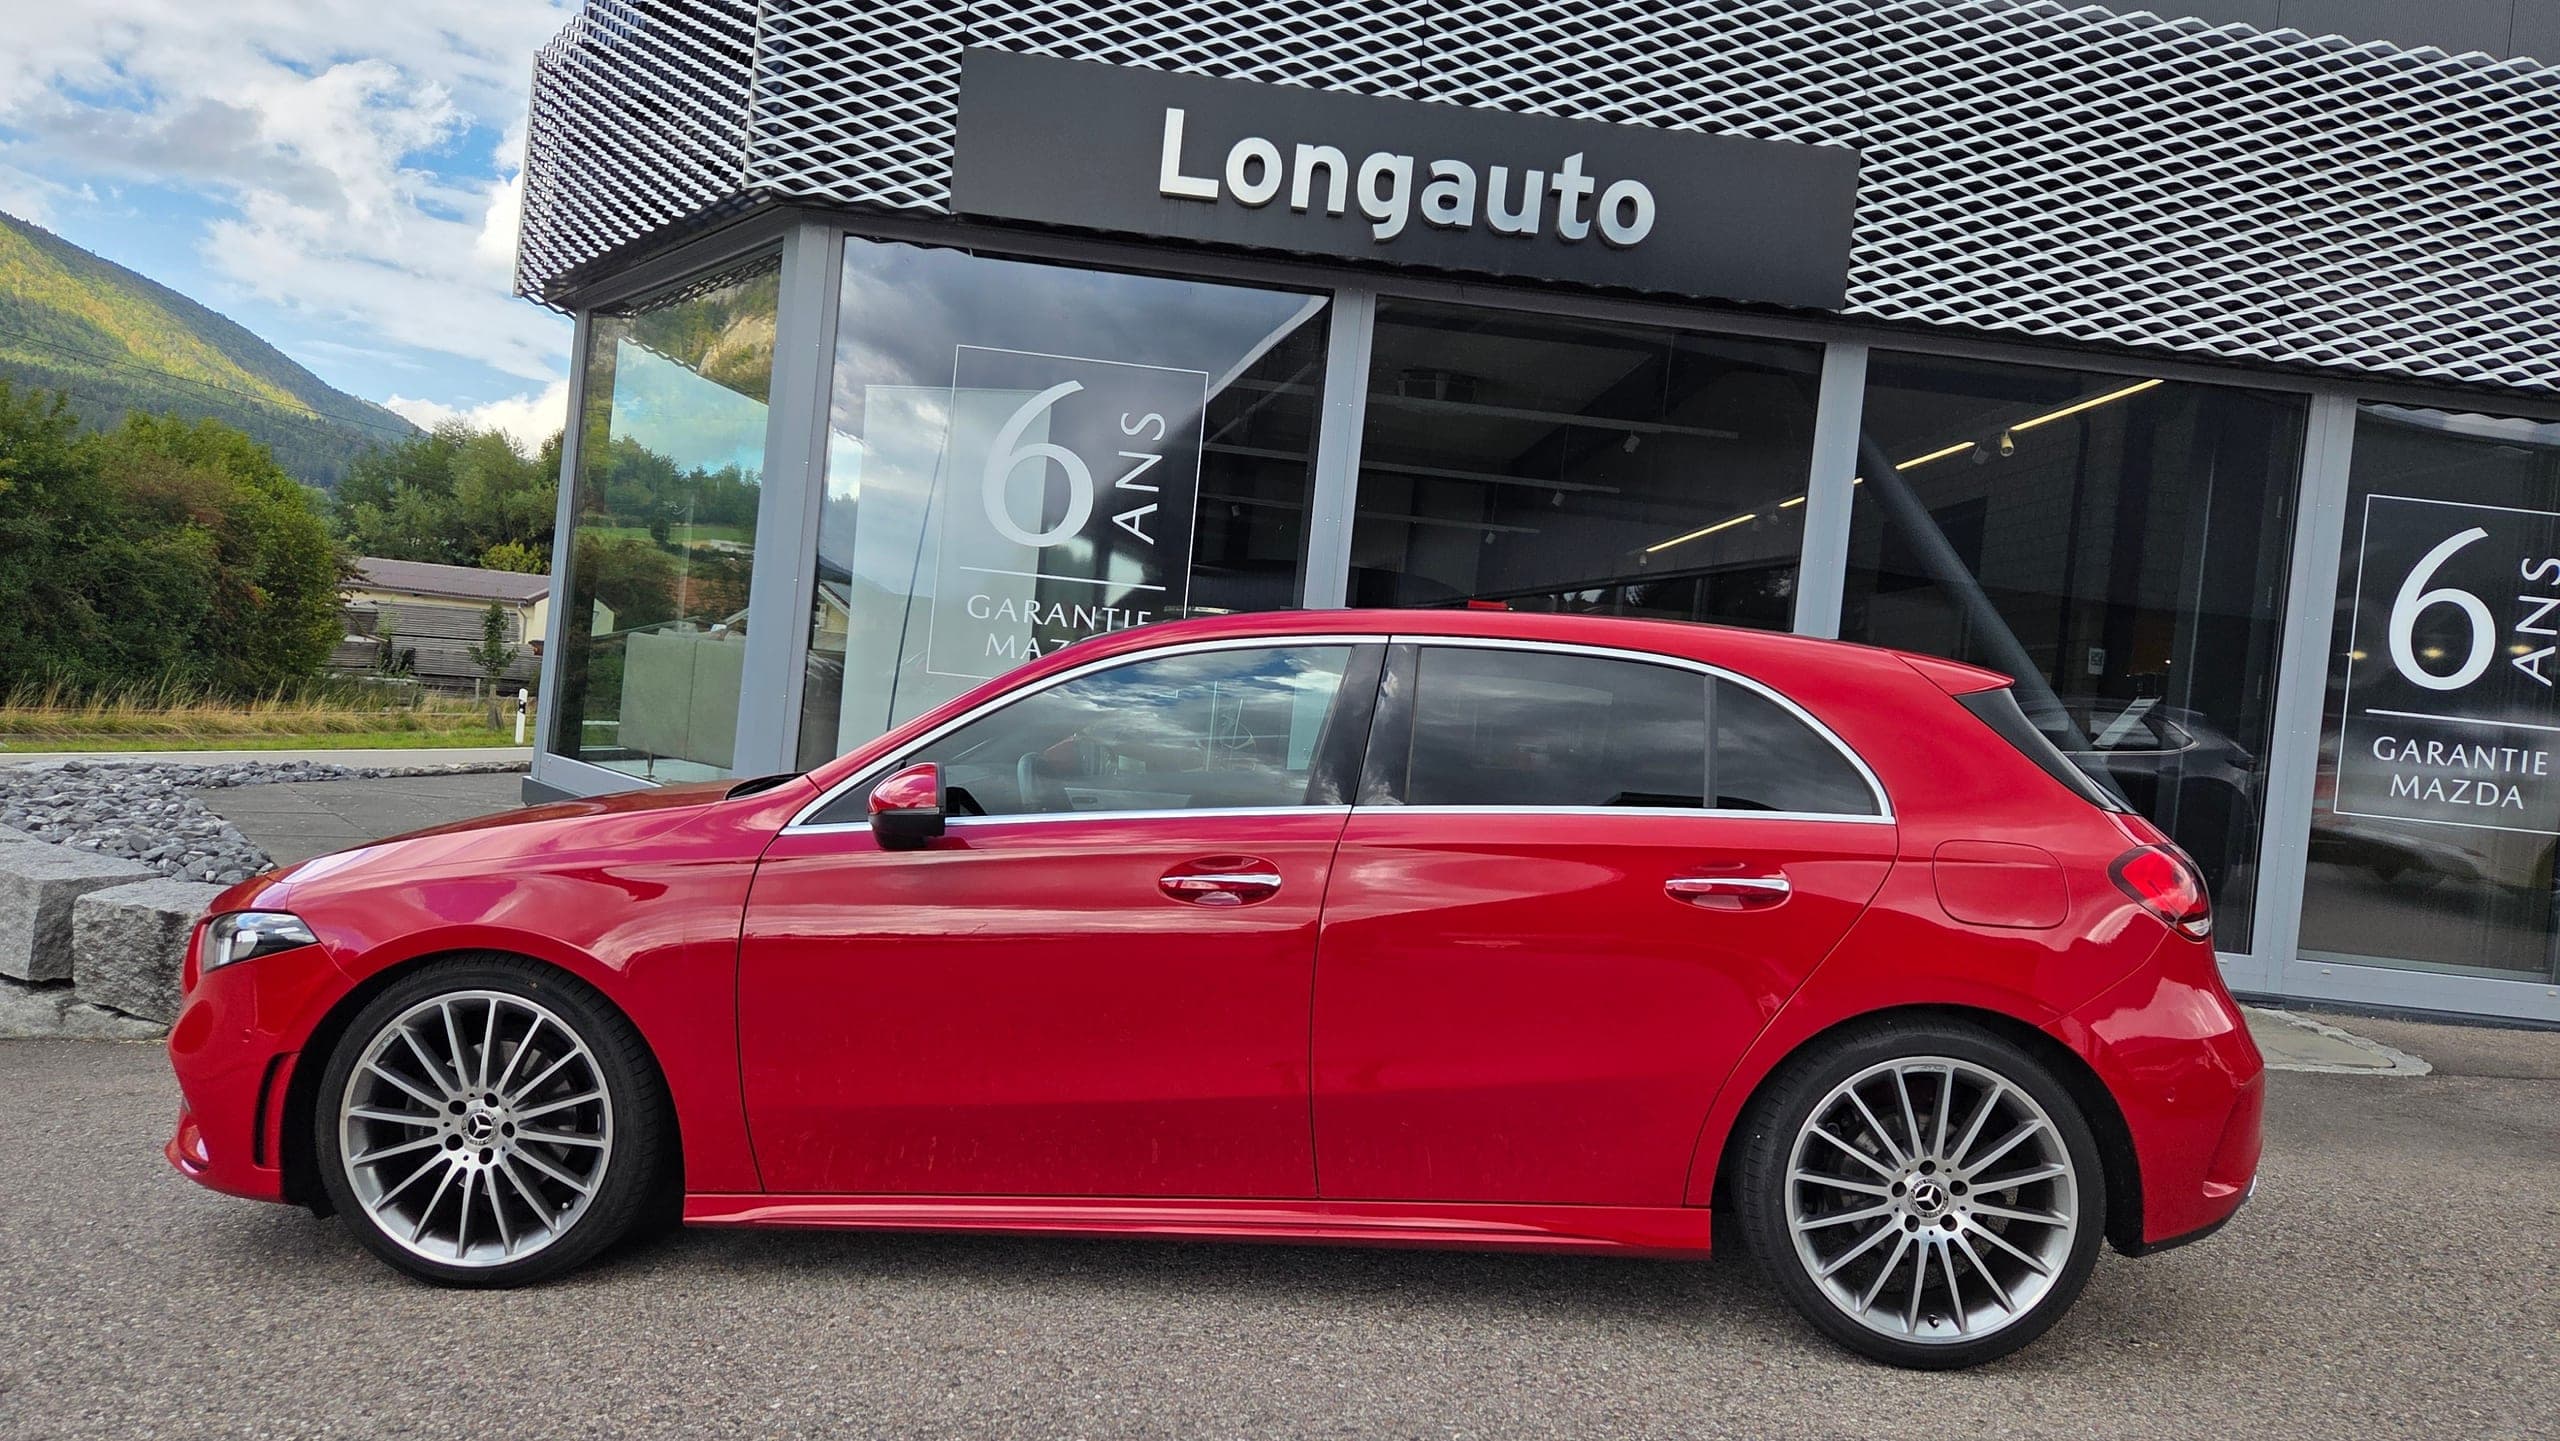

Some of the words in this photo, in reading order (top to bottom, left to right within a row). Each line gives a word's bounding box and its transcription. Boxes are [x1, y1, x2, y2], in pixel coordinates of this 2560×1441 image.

[1159, 107, 1656, 247] Longauto
[982, 380, 1094, 548] 6
[1111, 412, 1166, 545] ANS
[2388, 526, 2496, 691] 6
[2511, 558, 2560, 687] ANS
[2372, 736, 2549, 776] GARANTIE
[2389, 774, 2524, 810] MAZDA
